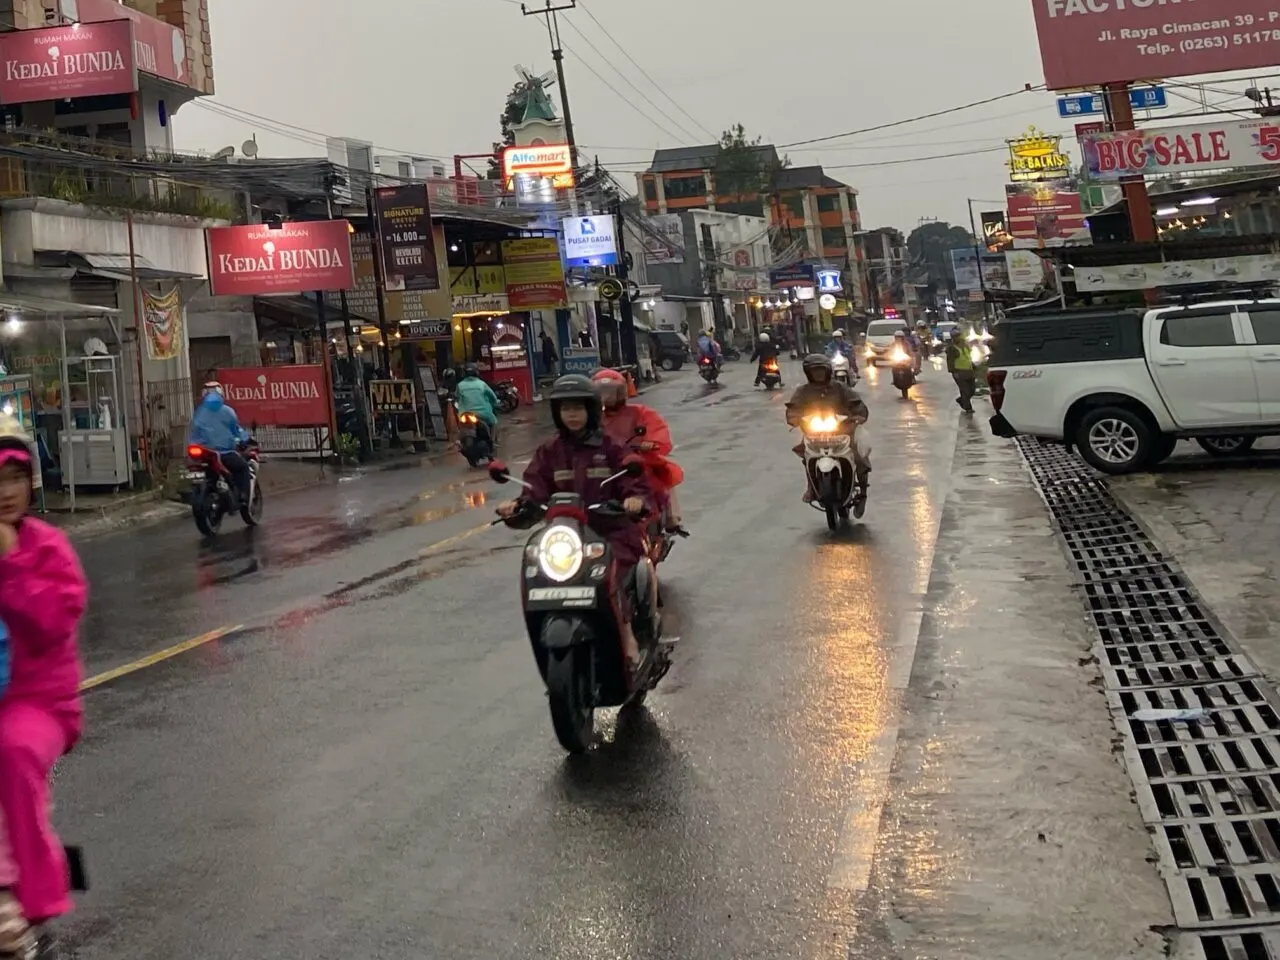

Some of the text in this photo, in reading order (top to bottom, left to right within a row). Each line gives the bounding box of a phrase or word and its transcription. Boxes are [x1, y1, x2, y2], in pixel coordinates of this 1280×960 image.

[1120, 27, 1158, 40] Raya
[1163, 18, 1230, 35] Cimacan
[1234, 14, 1254, 26] 39
[33, 31, 93, 46] RUMAH MAKAN
[1136, 42, 1175, 56] Telp.
[1179, 35, 1228, 54] (0263)
[6, 49, 125, 81] KEDAI BUNDA
[511, 150, 567, 164] Alfamart
[1095, 138, 1148, 173] BIG
[1153, 130, 1230, 167] SALE
[383, 207, 424, 218] SIGNATURE
[567, 235, 612, 245] PUSAT GADAI
[218, 252, 276, 274] KEDAI
[279, 247, 344, 271] BUNDA
[396, 255, 423, 266] KRETEK
[223, 380, 320, 400] KEDAI BUNDA
[373, 384, 412, 403] VILA
